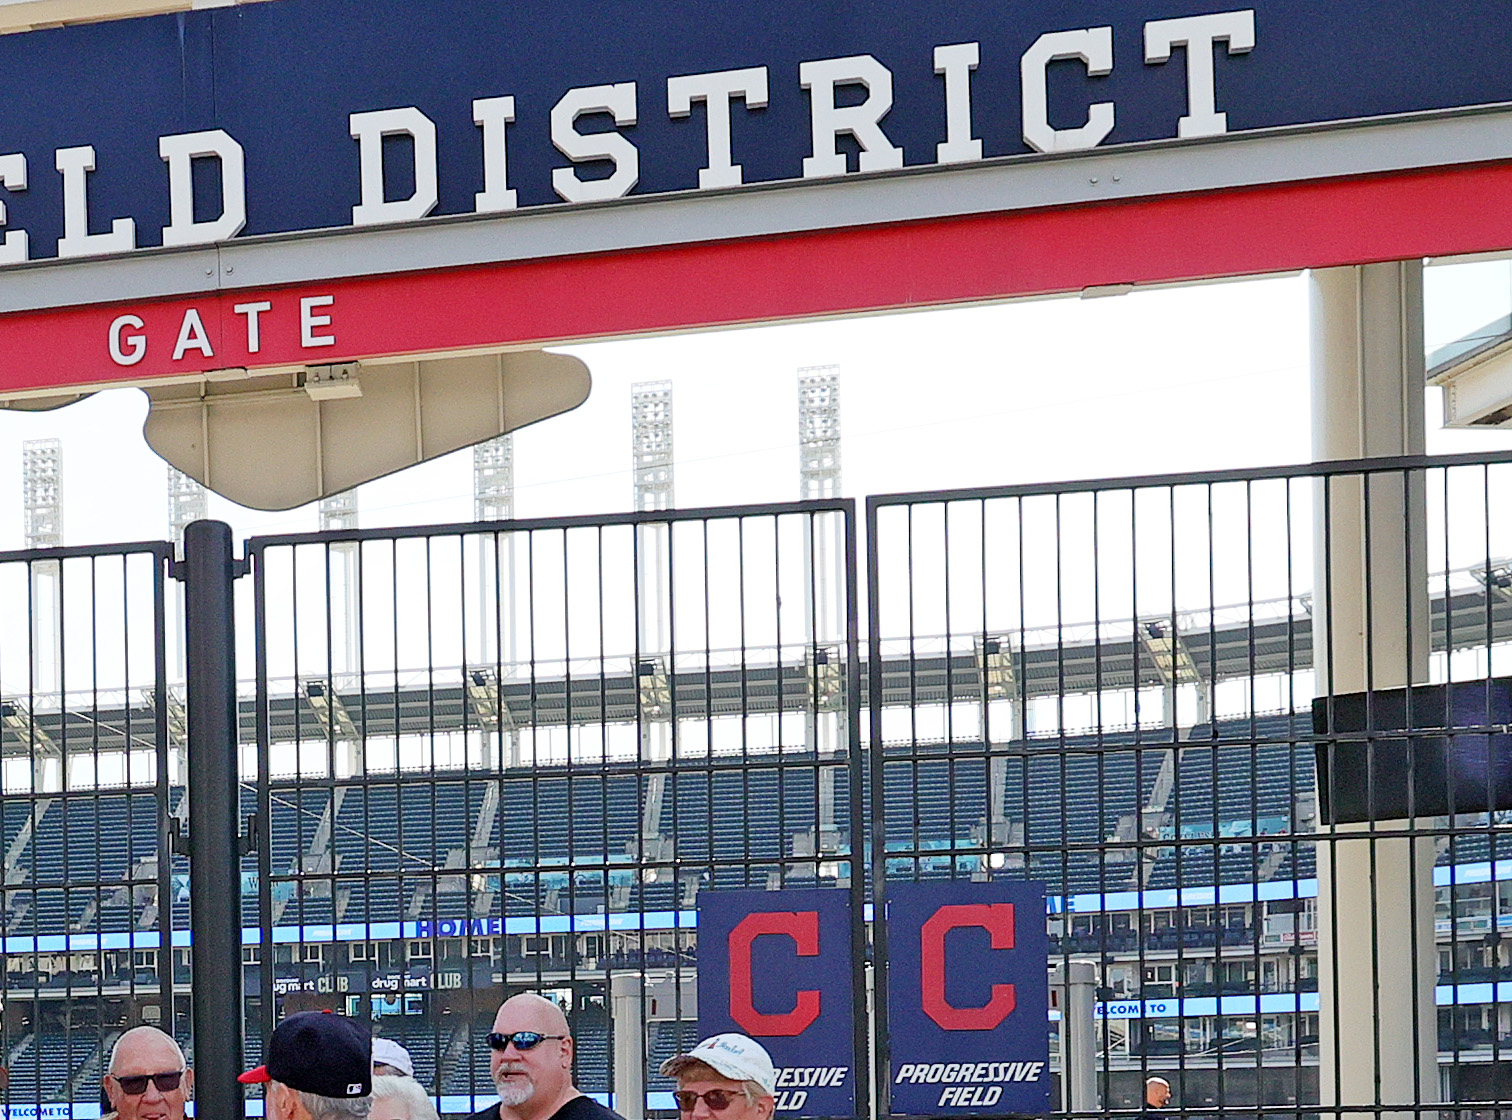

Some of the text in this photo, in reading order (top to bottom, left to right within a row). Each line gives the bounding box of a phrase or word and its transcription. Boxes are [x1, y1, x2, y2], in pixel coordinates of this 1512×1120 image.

[349, 9, 1255, 225] DISTRICT
[108, 295, 335, 366] GATE
[416, 917, 501, 939] HOME
[728, 910, 821, 1036] C
[920, 903, 1016, 1032] C
[372, 978, 399, 990] drug
[1149, 1003, 1167, 1014] TO
[894, 1060, 1044, 1085] PROGRESSIVE
[937, 1085, 1002, 1107] FIELD
[1, 1106, 70, 1118] WELCOME TO
